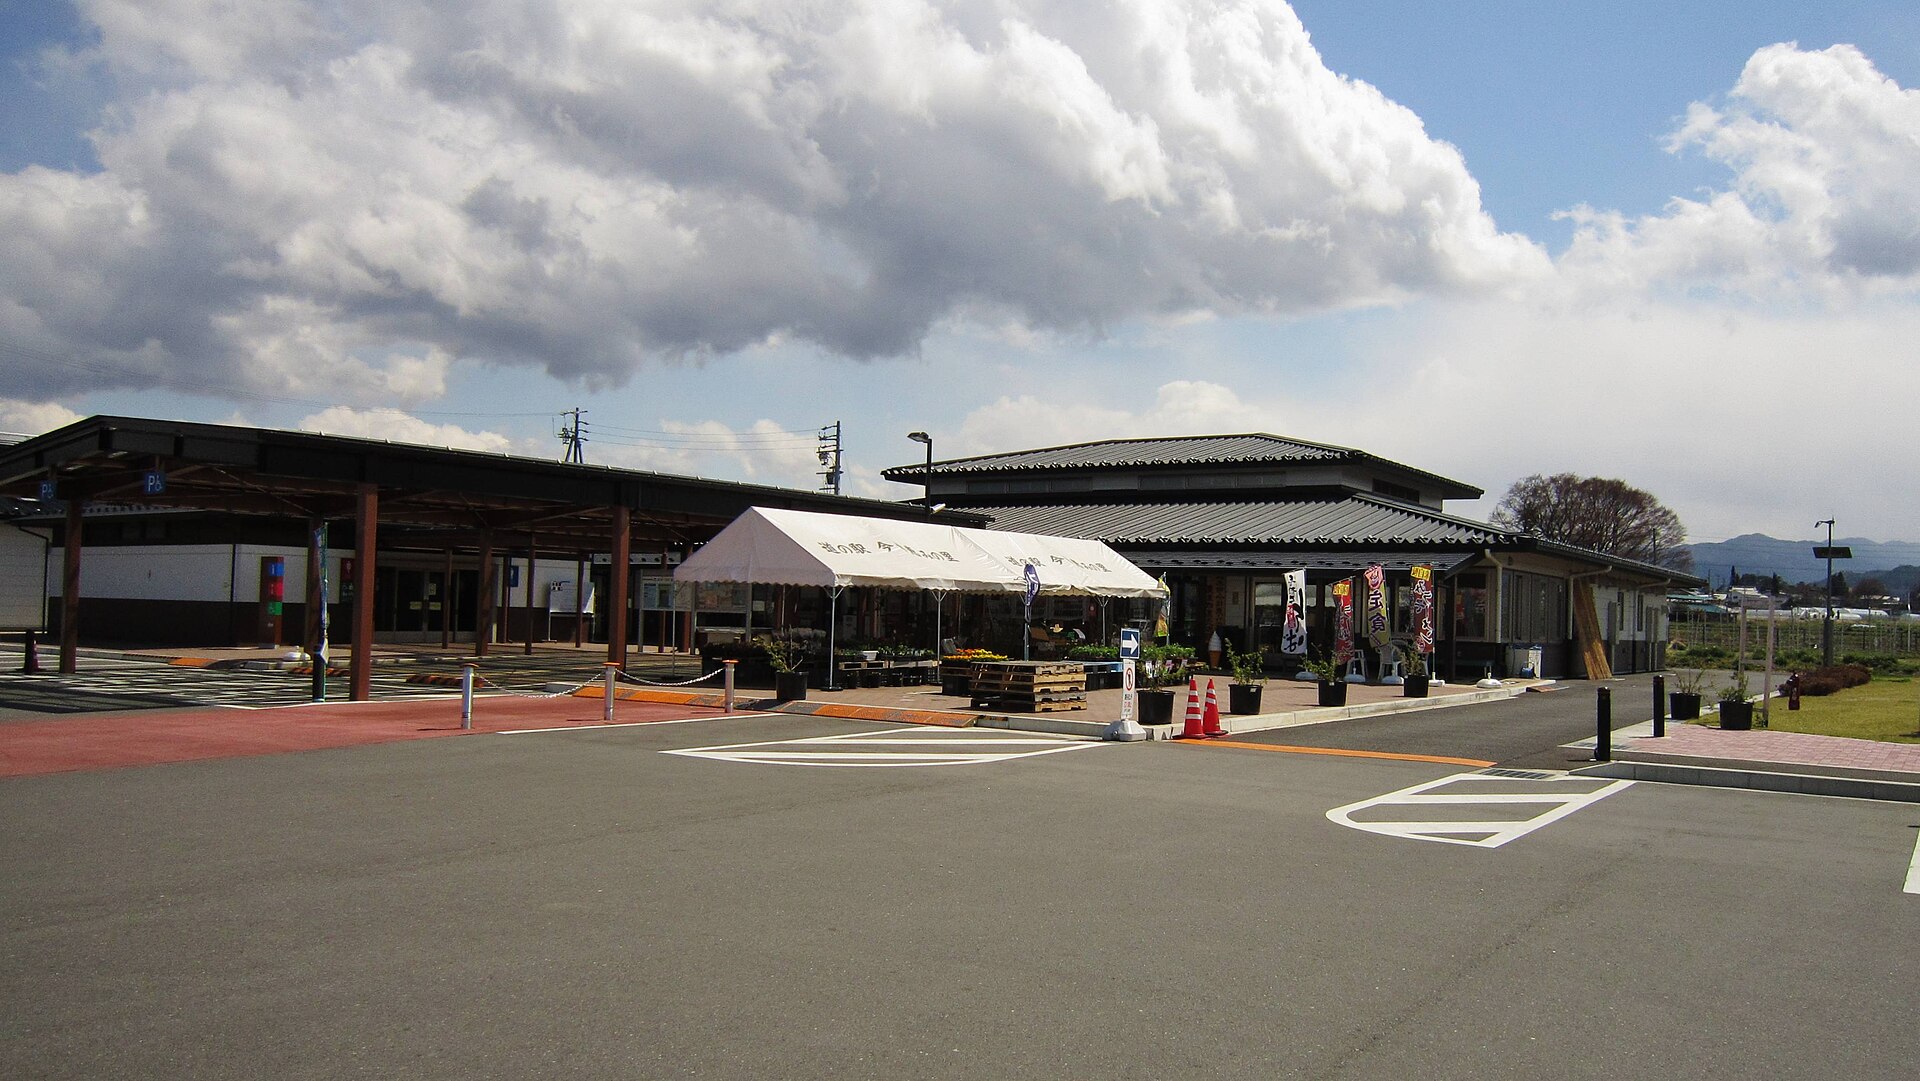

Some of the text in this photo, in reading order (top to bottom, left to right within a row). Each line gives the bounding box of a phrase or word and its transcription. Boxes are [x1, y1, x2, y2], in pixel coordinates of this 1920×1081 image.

[147, 475, 155, 493] P
[818, 541, 872, 554] 道の駅
